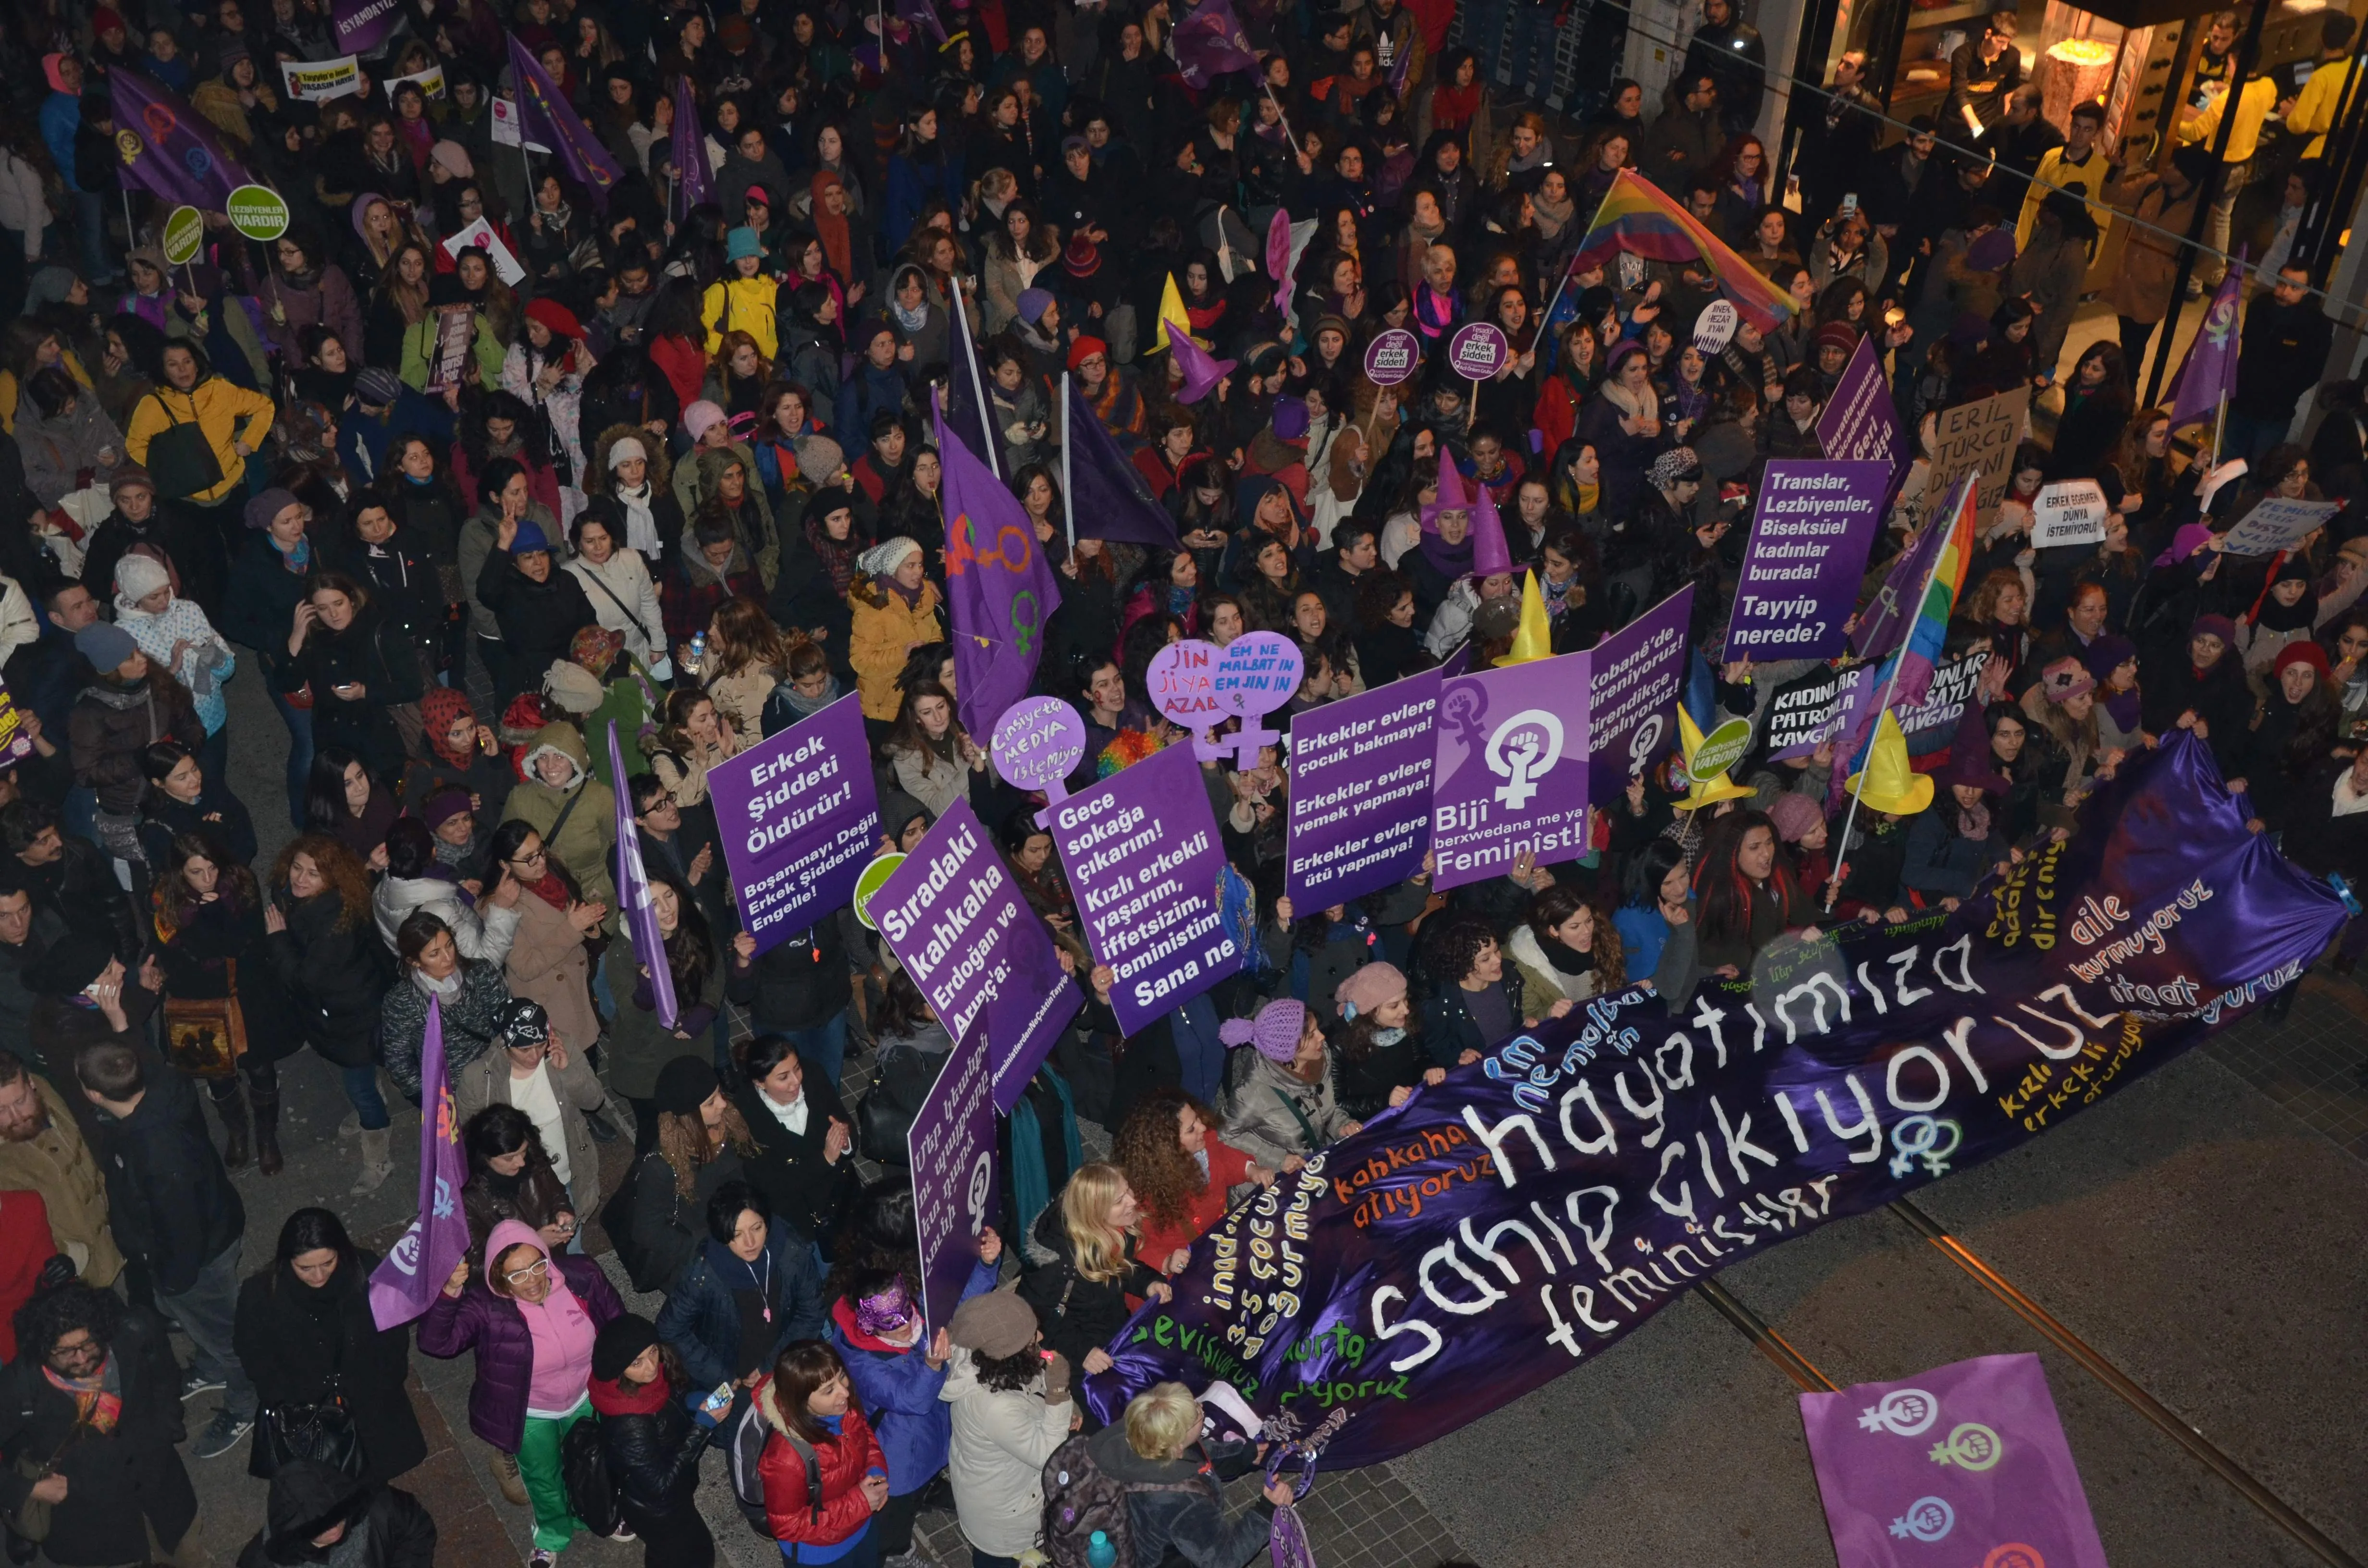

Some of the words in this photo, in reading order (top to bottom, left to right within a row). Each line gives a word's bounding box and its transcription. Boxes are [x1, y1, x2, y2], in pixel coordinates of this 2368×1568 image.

[231, 205, 284, 214] LEZBİYENLER
[234, 215, 284, 227] VARDIR
[169, 225, 201, 257] VARDIR
[1386, 341, 1403, 349] değil
[1466, 342, 1492, 353] erkek
[1471, 333, 1490, 343] değil
[1472, 326, 1494, 335] Tesadüf
[1376, 358, 1405, 368] şiddeti
[1380, 350, 1405, 358] erkek
[1461, 350, 1493, 361] şiddeti
[1826, 363, 1876, 456] Hayatlarımızın
[1950, 399, 2011, 433] ERİL
[1853, 415, 1878, 460] Geri
[1939, 422, 2013, 466] TÜRCÜ
[1772, 473, 1850, 491] Translar,
[2046, 494, 2070, 508] ERKEK
[2071, 492, 2099, 505] EGEMEN
[1760, 518, 1847, 535] Biseksüel
[1765, 496, 1874, 514] Lezbiyenler,
[2062, 508, 2088, 522] DÜNYA
[1749, 564, 1820, 580] burada!
[1754, 542, 1829, 559] kadınlar
[1742, 595, 1817, 619] Tayyip
[1231, 646, 1252, 658] EM
[1259, 644, 1280, 655] NE
[1734, 623, 1825, 644] nerede?
[1215, 677, 1240, 690] EM
[1242, 675, 1270, 690] JIN
[1274, 677, 1291, 692] IN
[1219, 659, 1277, 673] MALBAT
[1278, 659, 1294, 671] IN
[1771, 695, 1854, 730] PATRONLA
[1775, 671, 1861, 710] KADINLAR
[1297, 719, 1376, 755] Erkekler
[1381, 698, 1436, 726] evlere
[1589, 678, 1679, 753] oğalıyoruz!
[1770, 719, 1846, 747] KAVGADA
[750, 735, 826, 788] Erkek
[1004, 721, 1068, 764] MEDYA
[1298, 748, 1348, 777] çocuk
[1354, 716, 1432, 756] bakmaya!
[1695, 746, 1742, 771] VARDIR
[748, 755, 839, 822] Şiddeti
[1039, 768, 1064, 785] RUZ
[1295, 779, 1372, 816] Erkekler
[1378, 758, 1432, 787] evlere
[747, 781, 852, 853] Öldürür!
[1059, 793, 1115, 830] Gece
[1294, 808, 1348, 837] yemek
[1354, 775, 1430, 817] yapmaya!
[1435, 820, 1531, 849] berxwedana
[1537, 813, 1560, 825] me
[1566, 808, 1582, 825] ya
[1436, 799, 1489, 832] Bijî
[1067, 806, 1145, 856] sokağa
[1077, 819, 1164, 885] çıkarım!
[1293, 838, 1369, 874] Erkekler
[1374, 816, 1428, 845] evlere
[1437, 823, 1581, 875] Feminîst!
[744, 842, 833, 900] Boşanmayı
[837, 811, 878, 845] Değil
[748, 880, 796, 916] Erkek
[800, 836, 870, 888] Şiddetini
[1085, 876, 1134, 913] Kızlı
[1139, 831, 1209, 883] erkekli
[1306, 870, 1332, 887] ütü
[1338, 837, 1413, 877] yapmaya!
[882, 822, 978, 943] Sıradaki
[752, 885, 817, 932] Engelle!
[907, 865, 1003, 982] kahkaha
[1093, 877, 1184, 937] yaşarım,
[1101, 895, 1207, 960] iffetsizim,
[2071, 895, 2130, 945] aile
[1111, 913, 1221, 984] feministim
[2069, 878, 2213, 983] kurmuyoruz
[932, 927, 999, 1011] Erdoğan
[998, 902, 1017, 929] ve
[1135, 961, 1199, 1007] Sana
[1205, 939, 1236, 968] ne
[952, 957, 1011, 1038] Arınç'a:
[2106, 974, 2200, 1006] itaat
[1462, 933, 1986, 1188] hayatımıza
[2024, 1041, 2108, 1131] erkekli
[1334, 1125, 1471, 1204] kahkaha
[1354, 1153, 1496, 1228] atıyoruz
[1541, 1175, 1839, 1357] feministler
[1228, 1289, 1262, 1345] 3-5
